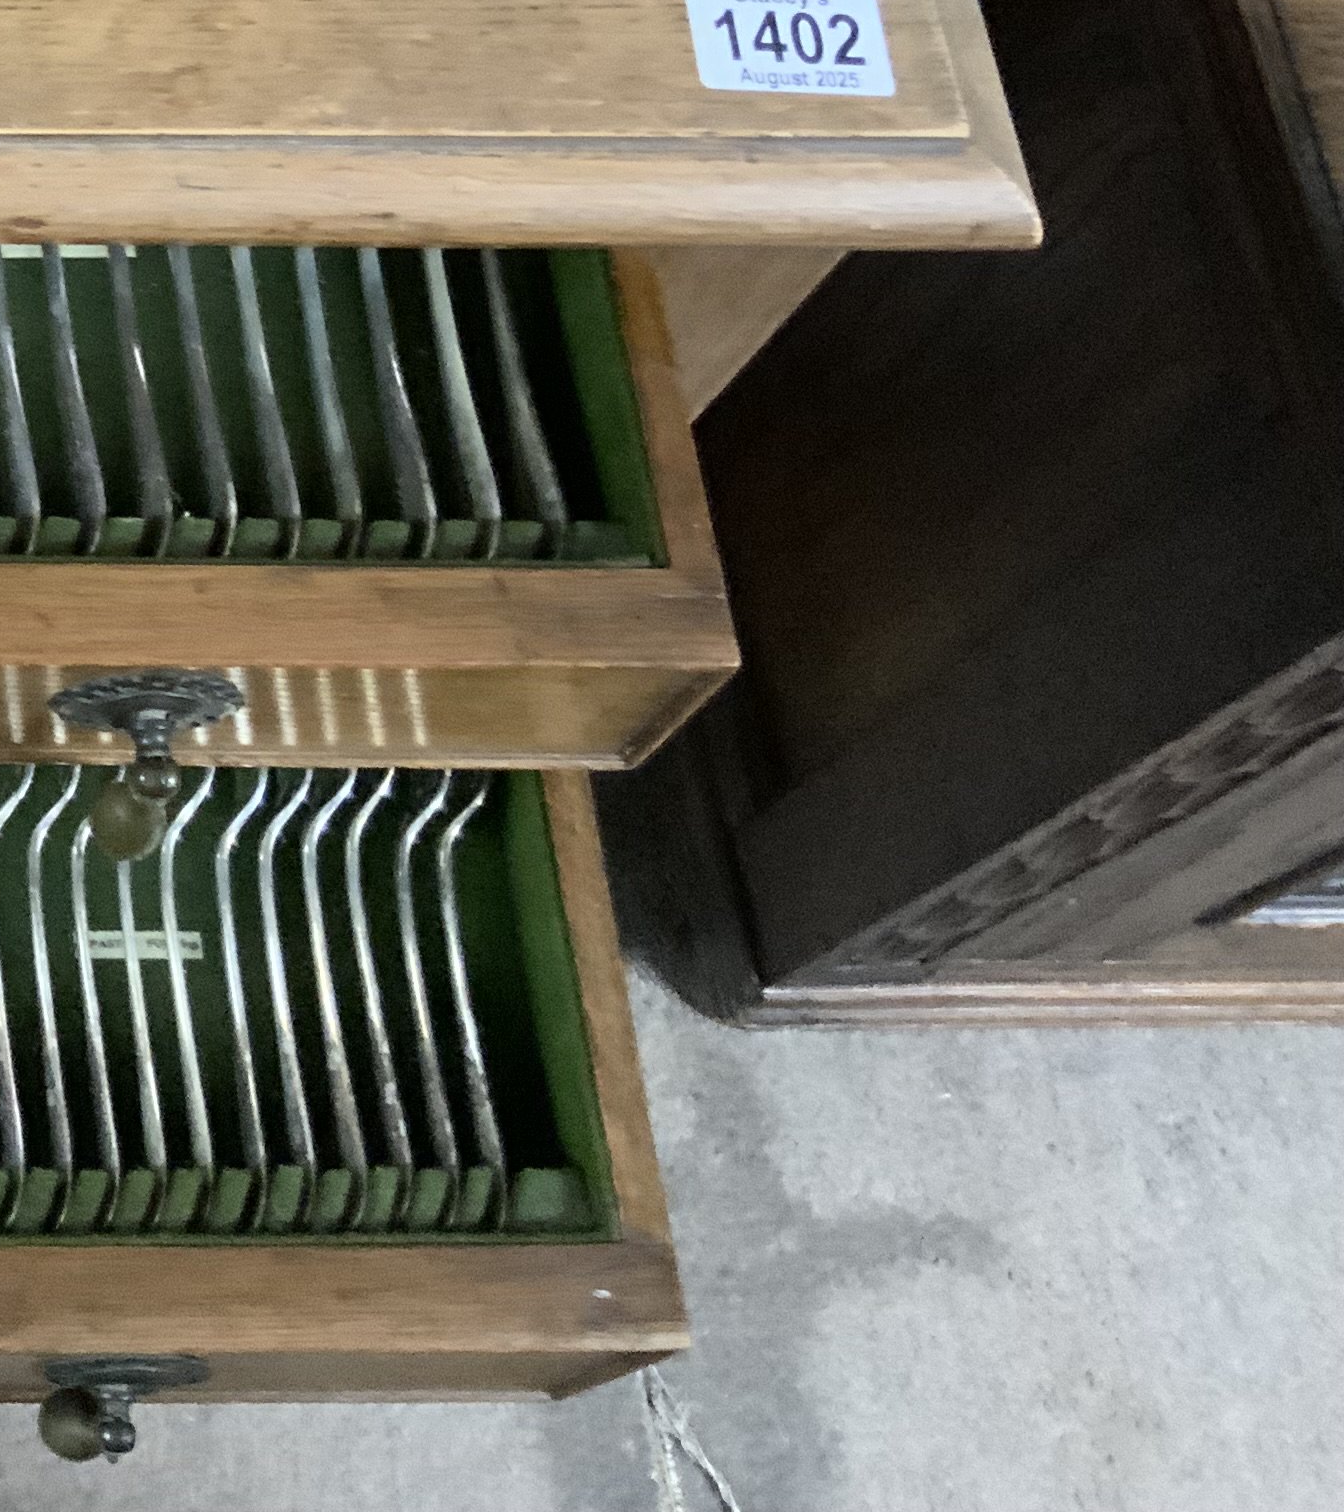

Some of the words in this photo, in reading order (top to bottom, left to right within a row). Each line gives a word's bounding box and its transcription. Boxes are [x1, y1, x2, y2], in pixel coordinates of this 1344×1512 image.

[714, 9, 866, 66] 1402
[741, 68, 809, 88] August
[816, 70, 860, 88] 2025
